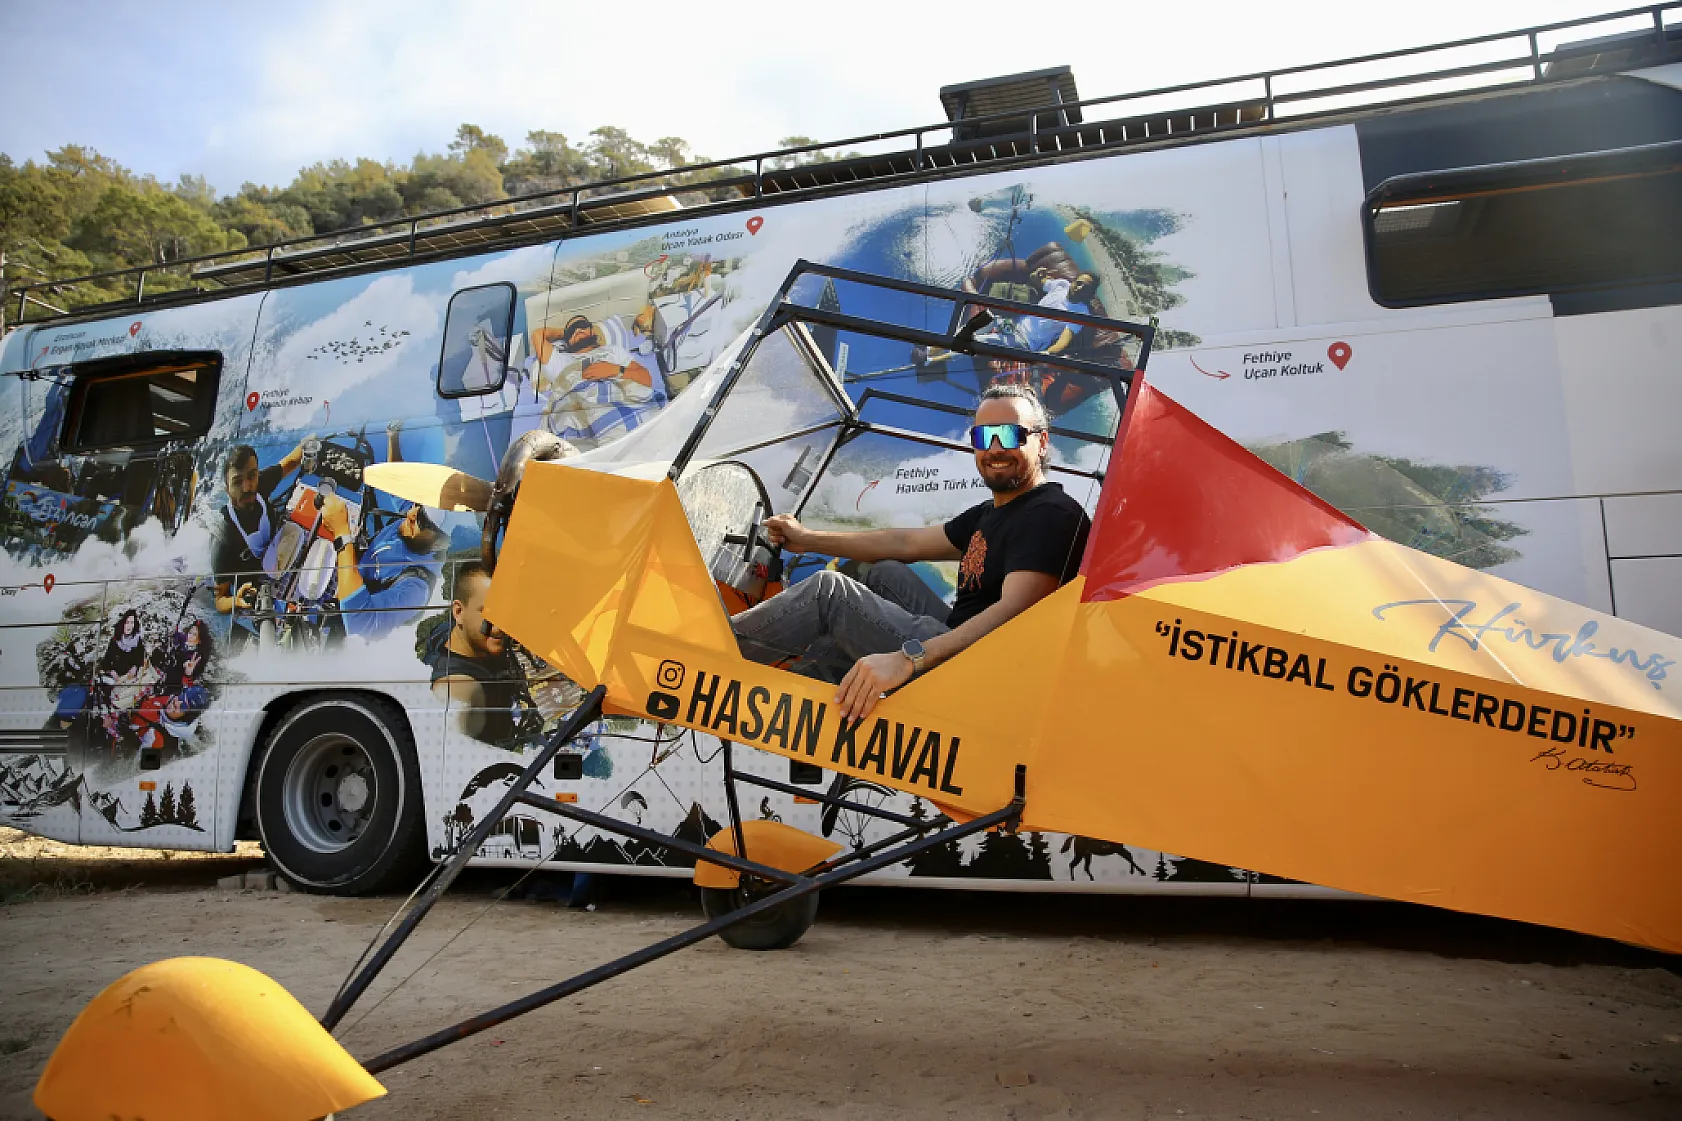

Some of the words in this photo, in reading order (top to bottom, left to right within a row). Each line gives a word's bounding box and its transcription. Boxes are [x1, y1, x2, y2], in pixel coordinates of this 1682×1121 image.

[1243, 351, 1292, 364] Fethiye
[1244, 368, 1277, 381] Uçan
[1281, 362, 1324, 376] Koltuk
[896, 467, 939, 480] Fethiye
[896, 483, 939, 494] Havada
[942, 478, 968, 491] Türk
[685, 670, 827, 756] HASAN
[830, 714, 964, 797] KAVAL
